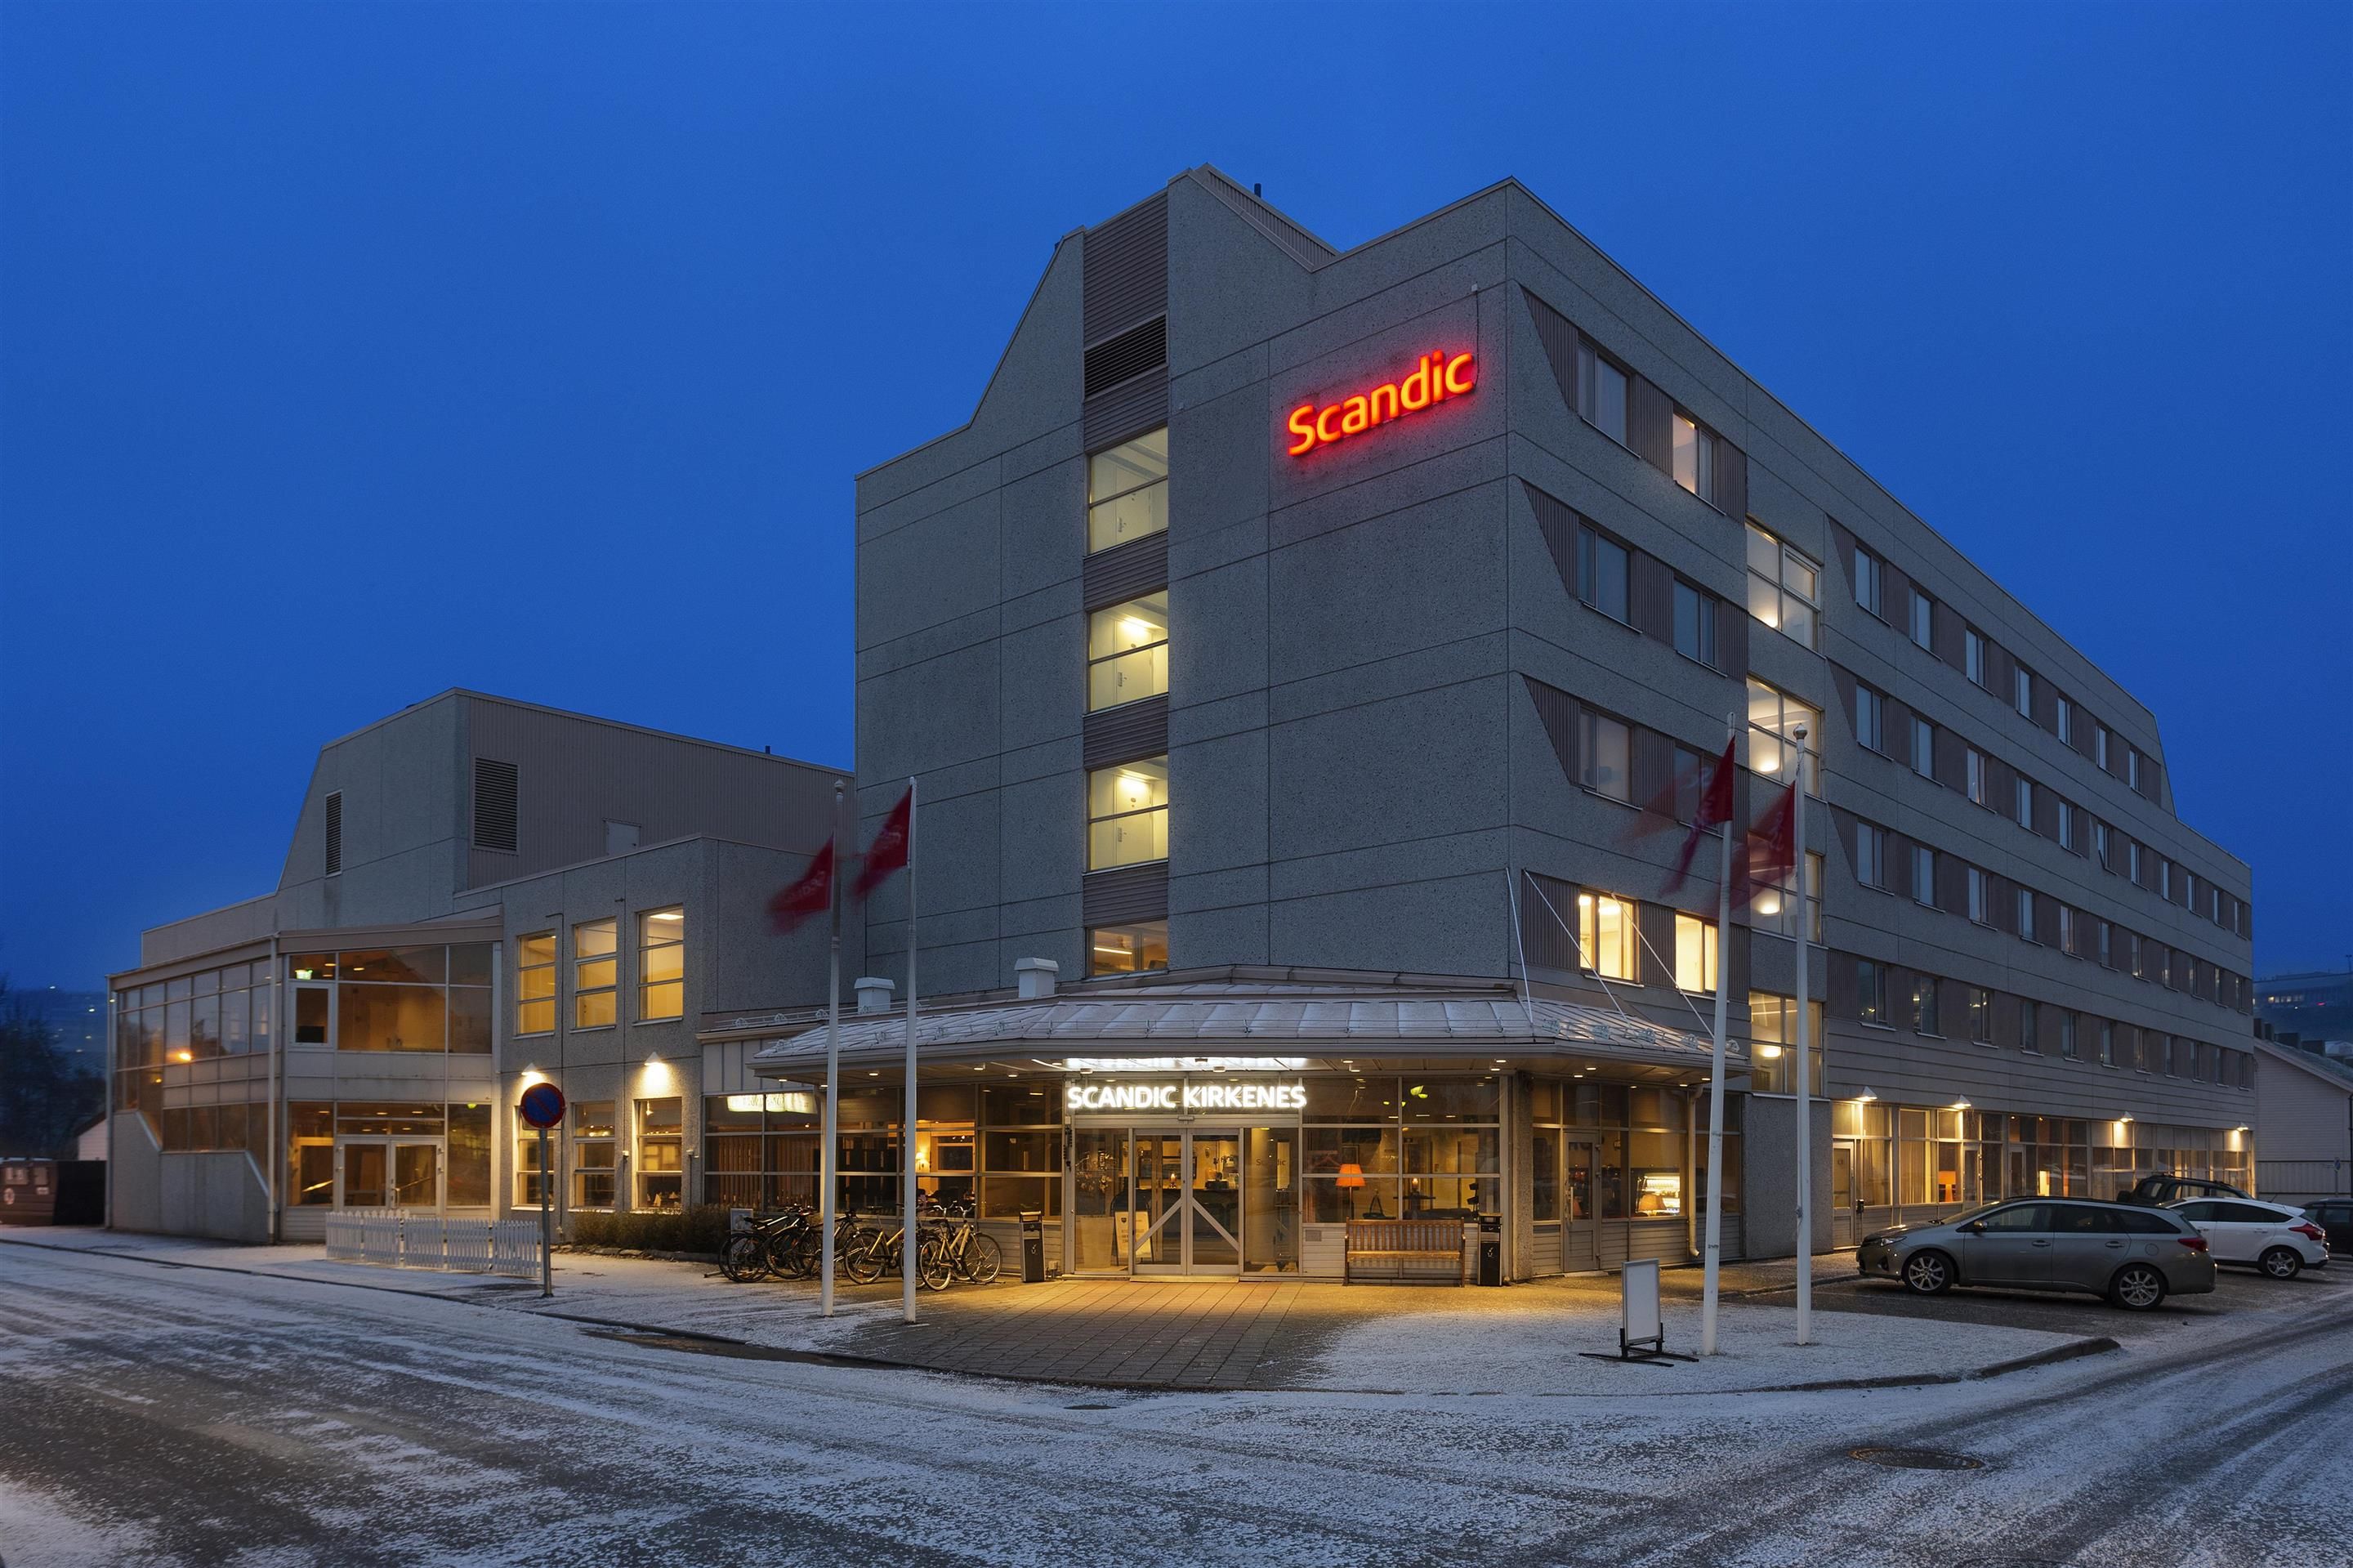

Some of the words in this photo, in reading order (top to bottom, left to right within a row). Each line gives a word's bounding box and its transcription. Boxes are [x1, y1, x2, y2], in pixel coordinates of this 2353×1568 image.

[1288, 349, 1473, 456] Scandic
[1067, 1085, 1176, 1109] SCANDIC
[1184, 1085, 1307, 1109] KIRKENES
